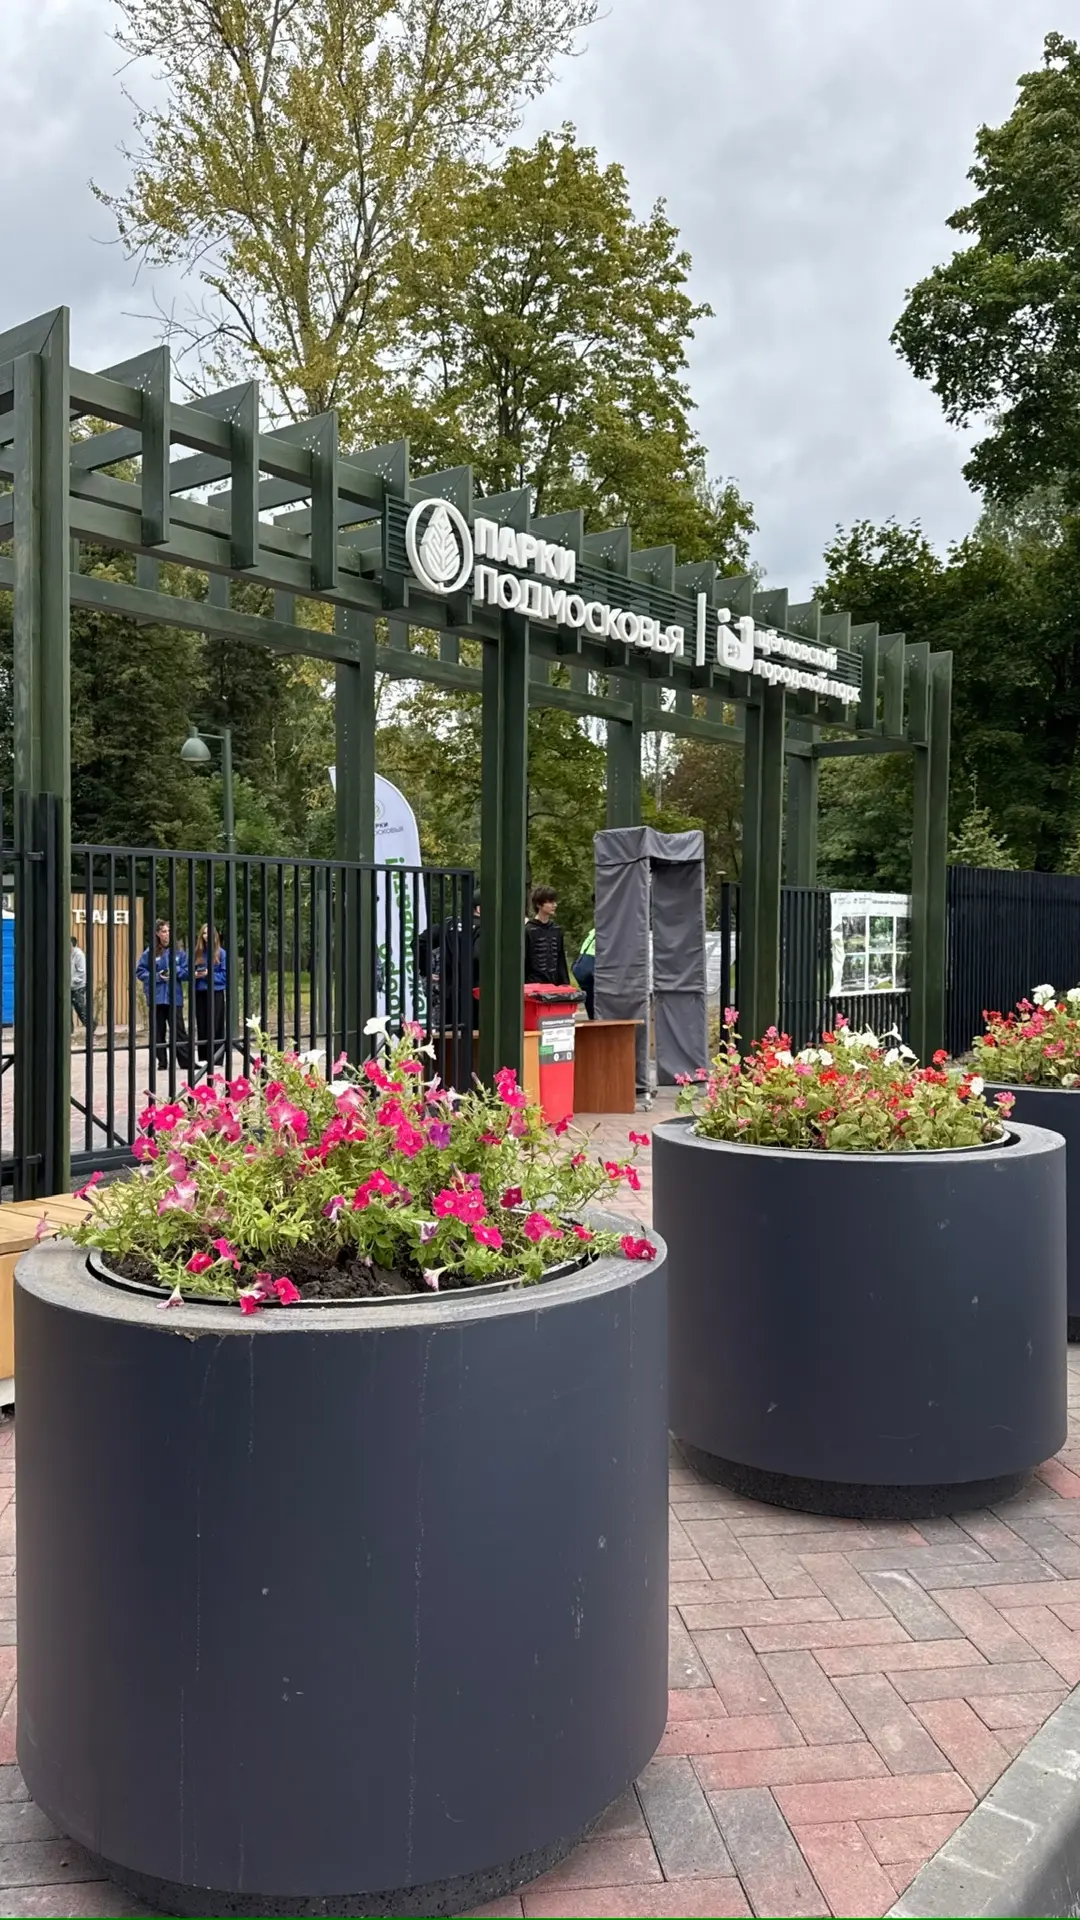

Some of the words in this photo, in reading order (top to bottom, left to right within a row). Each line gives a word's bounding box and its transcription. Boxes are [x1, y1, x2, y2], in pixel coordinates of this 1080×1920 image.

[474, 517, 576, 584] ПАРКИ
[474, 564, 685, 657] ПОДМОСКОВЬЯ
[753, 659, 828, 695] городской
